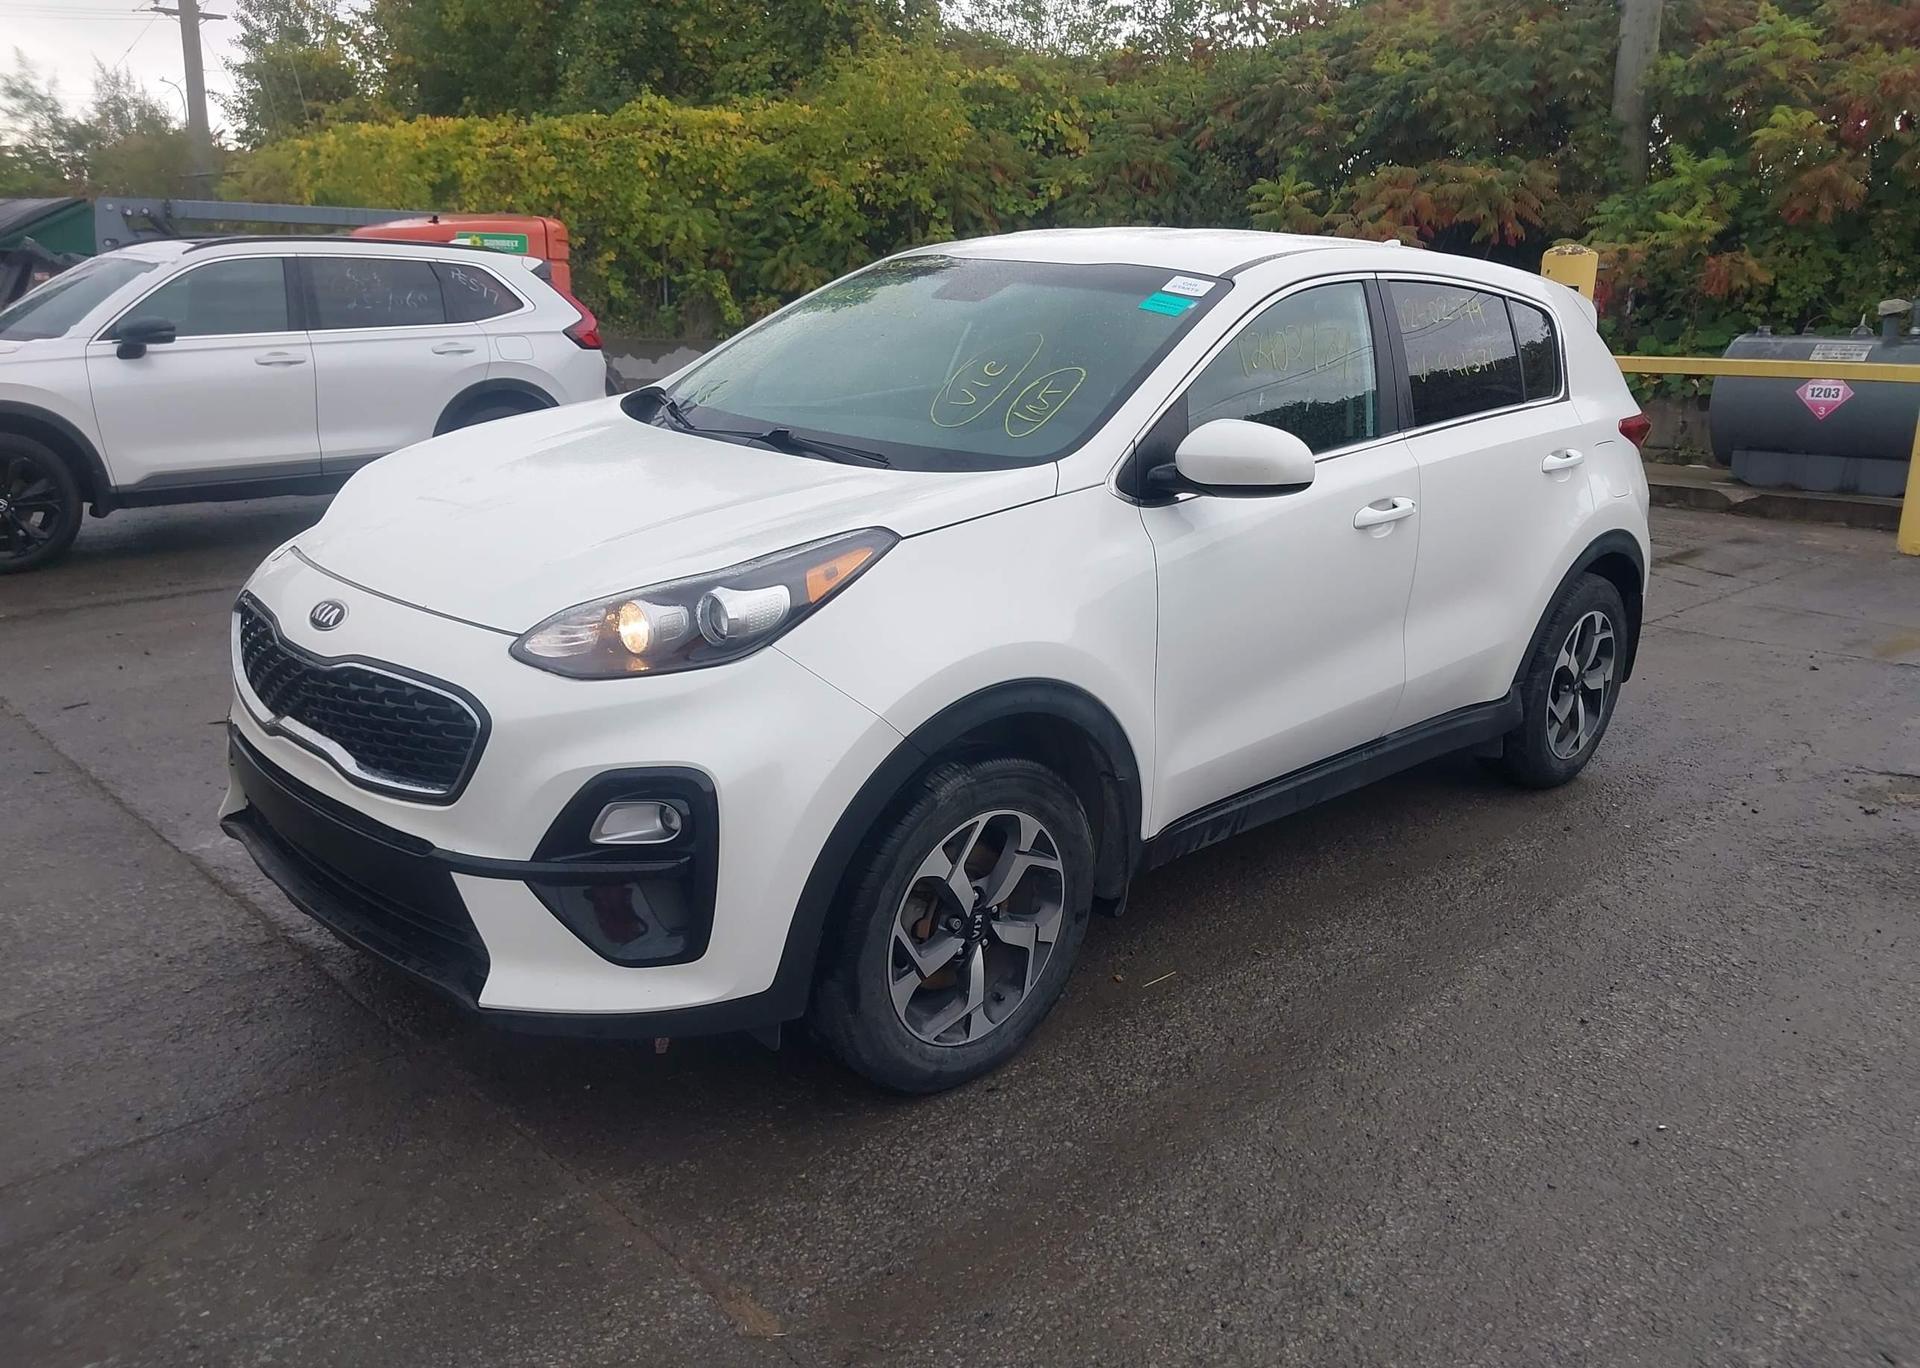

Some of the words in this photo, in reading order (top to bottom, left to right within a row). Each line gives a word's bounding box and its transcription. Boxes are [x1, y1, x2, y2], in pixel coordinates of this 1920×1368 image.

[949, 360, 1008, 405] VIC
[1809, 386, 1841, 399] 1203
[1817, 406, 1826, 415] 3
[311, 602, 341, 626] KIA
[972, 914, 983, 938] KIA
